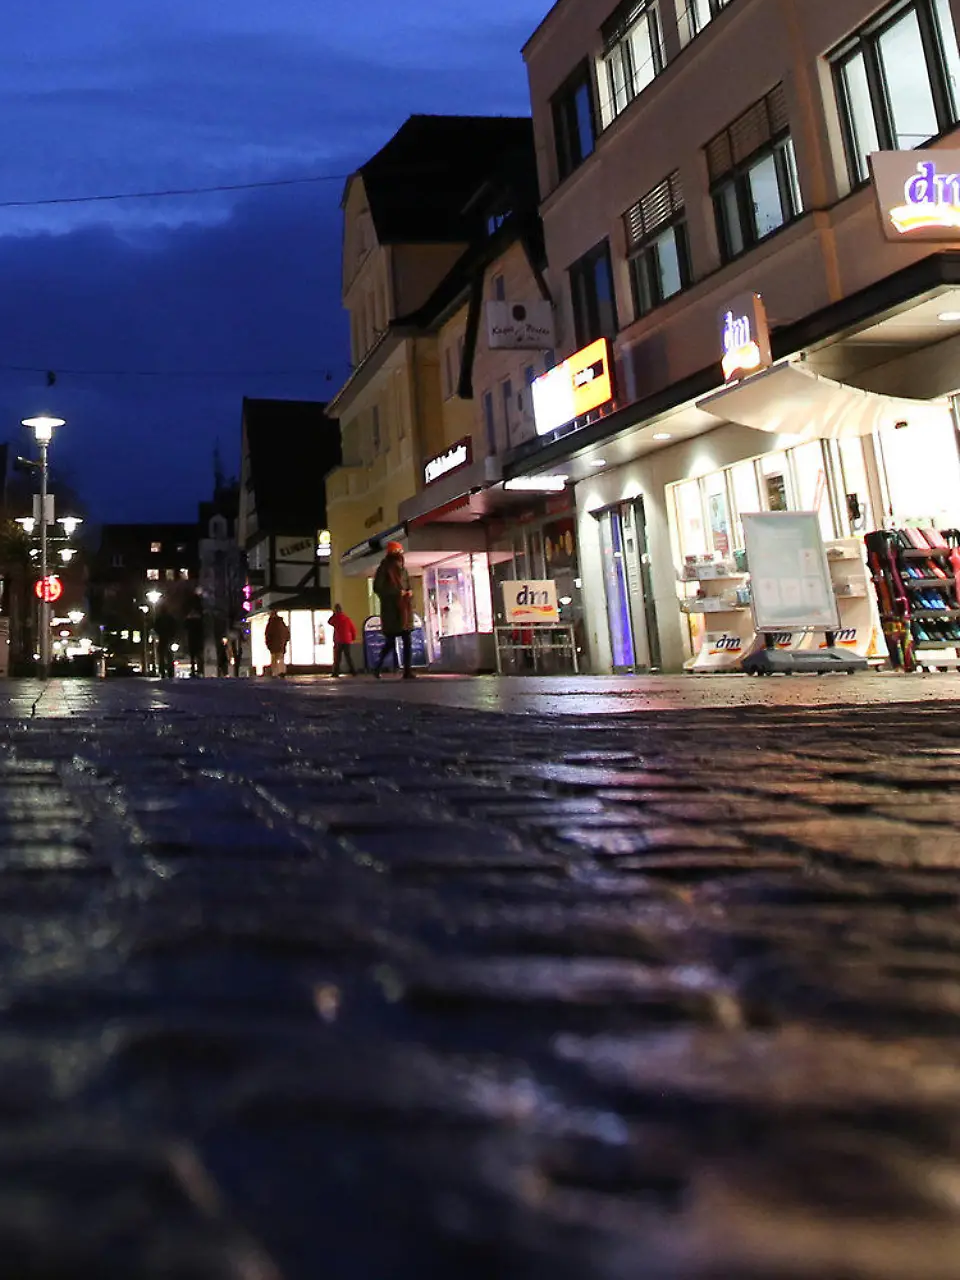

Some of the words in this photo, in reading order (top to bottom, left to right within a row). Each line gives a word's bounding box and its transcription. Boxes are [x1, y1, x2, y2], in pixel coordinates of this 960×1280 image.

[722, 310, 750, 352] dm
[516, 585, 549, 606] dm
[716, 635, 740, 648] dm
